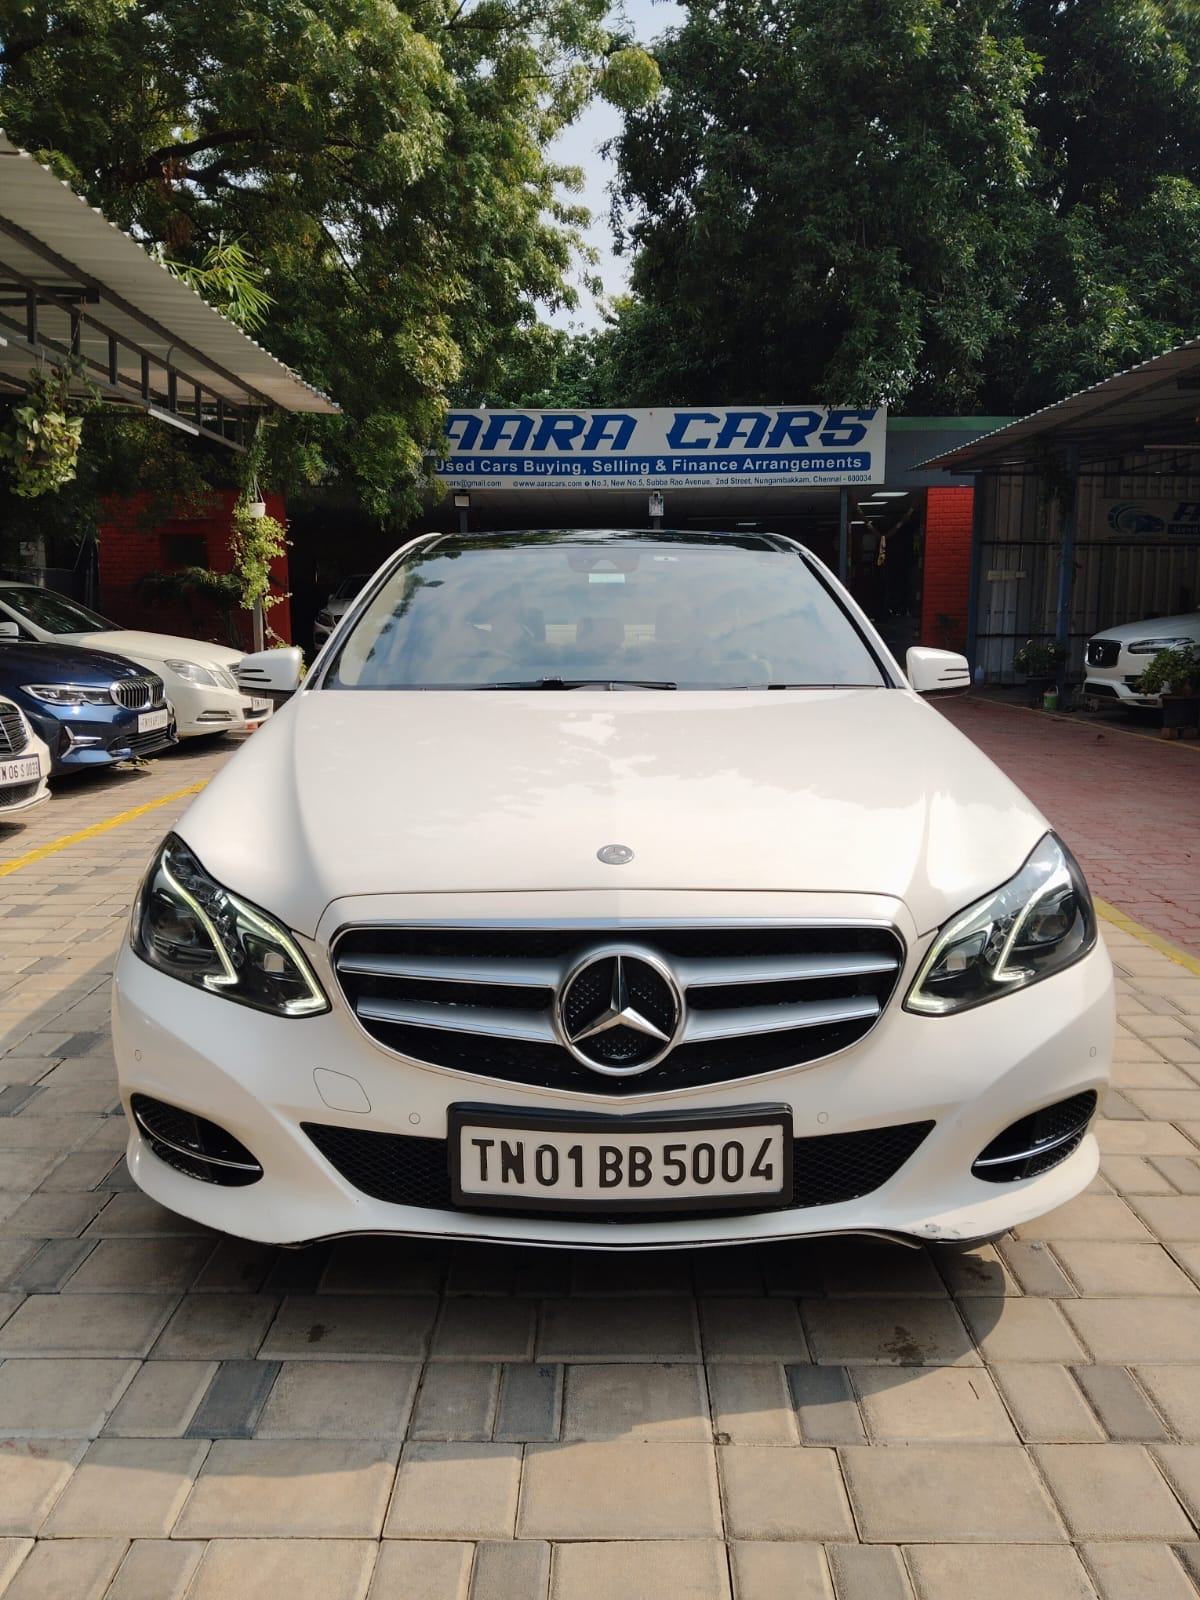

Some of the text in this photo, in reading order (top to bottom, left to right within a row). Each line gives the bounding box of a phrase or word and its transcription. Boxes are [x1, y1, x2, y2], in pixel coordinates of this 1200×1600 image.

[443, 410, 877, 451] AARA CARS
[436, 456, 862, 475] Used Cars Buying, Selling & Finance Arrangements
[445, 479, 502, 488] cars@gmail.com
[611, 479, 626, 487] New
[716, 477, 729, 485] 2nd
[813, 475, 841, 483] Chennai
